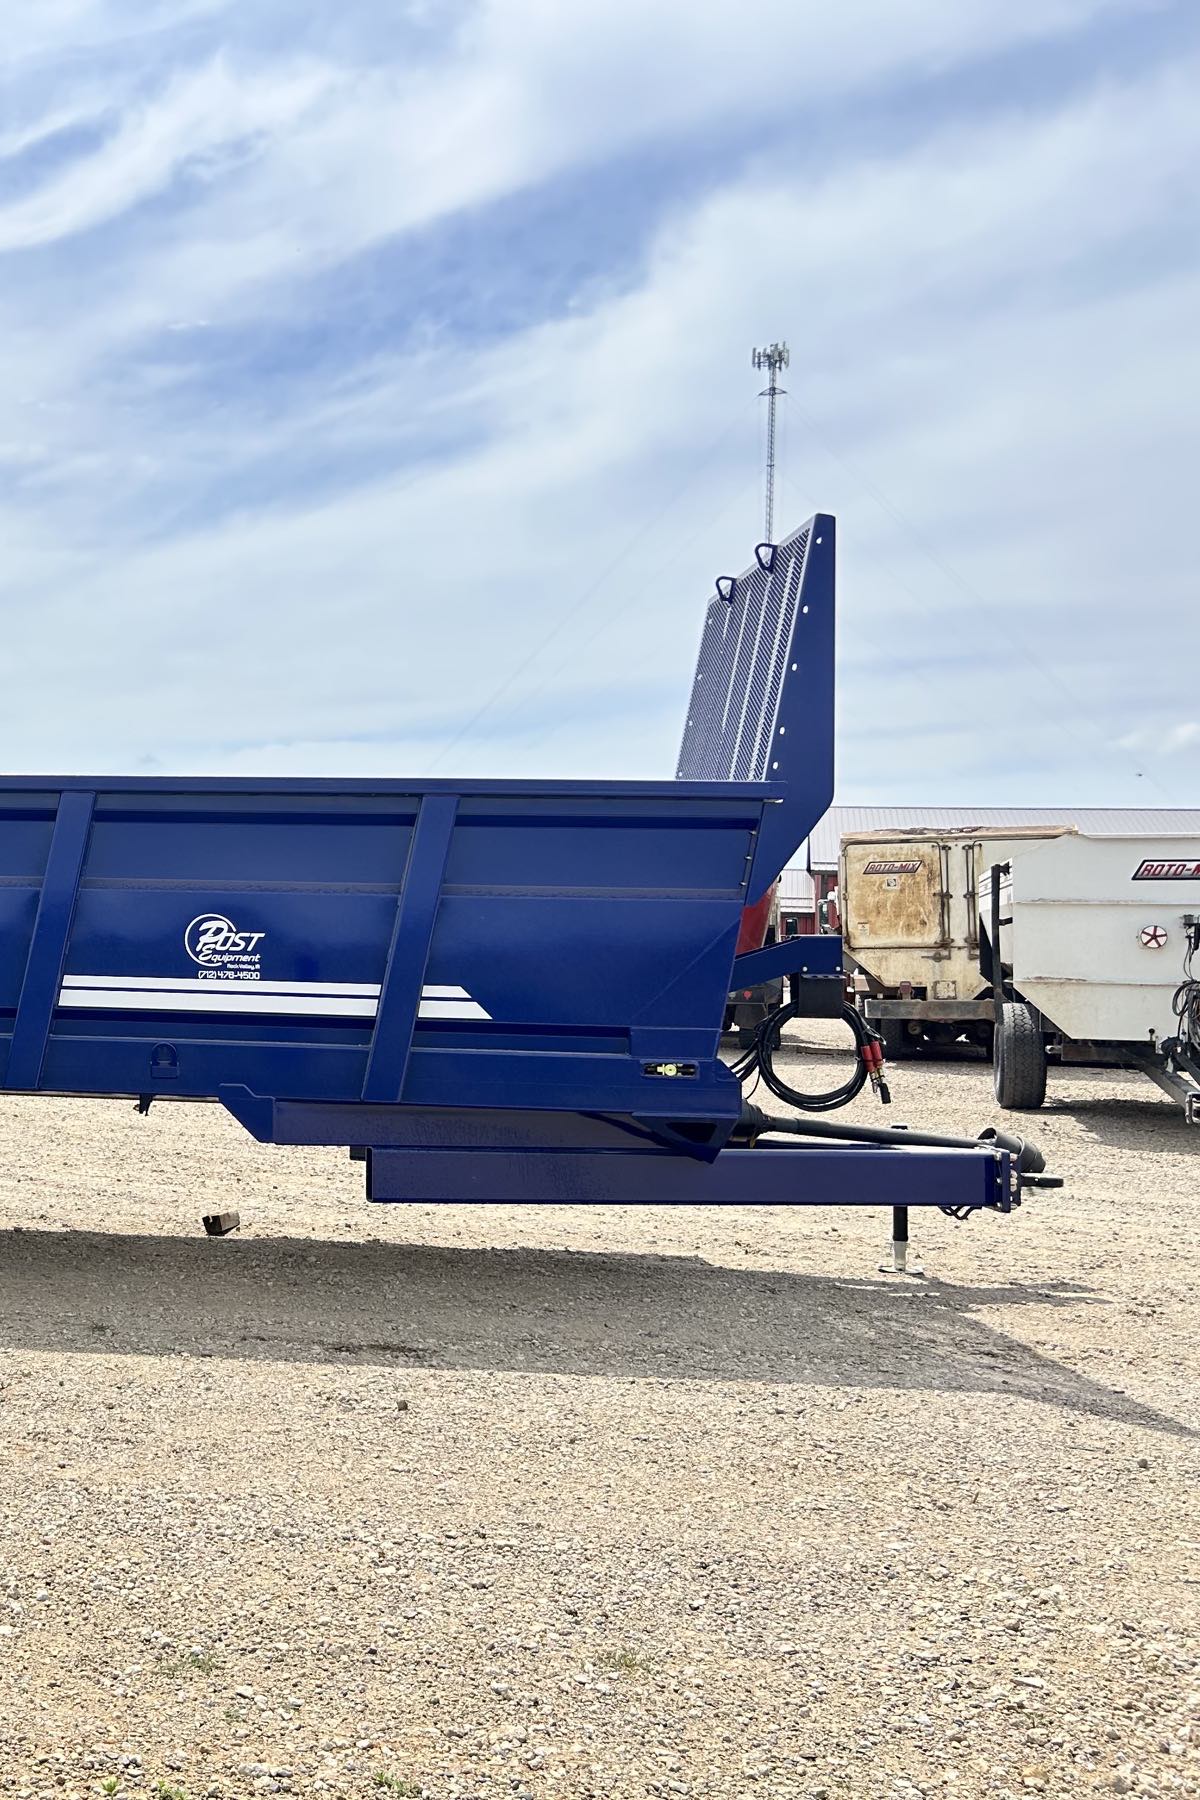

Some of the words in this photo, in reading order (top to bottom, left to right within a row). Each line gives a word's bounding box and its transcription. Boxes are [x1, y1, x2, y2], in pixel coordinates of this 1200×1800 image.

[867, 862, 918, 873] ROTO-MIX
[196, 920, 266, 952] POST
[198, 943, 261, 963] Equipment
[198, 970, 217, 979] (712)
